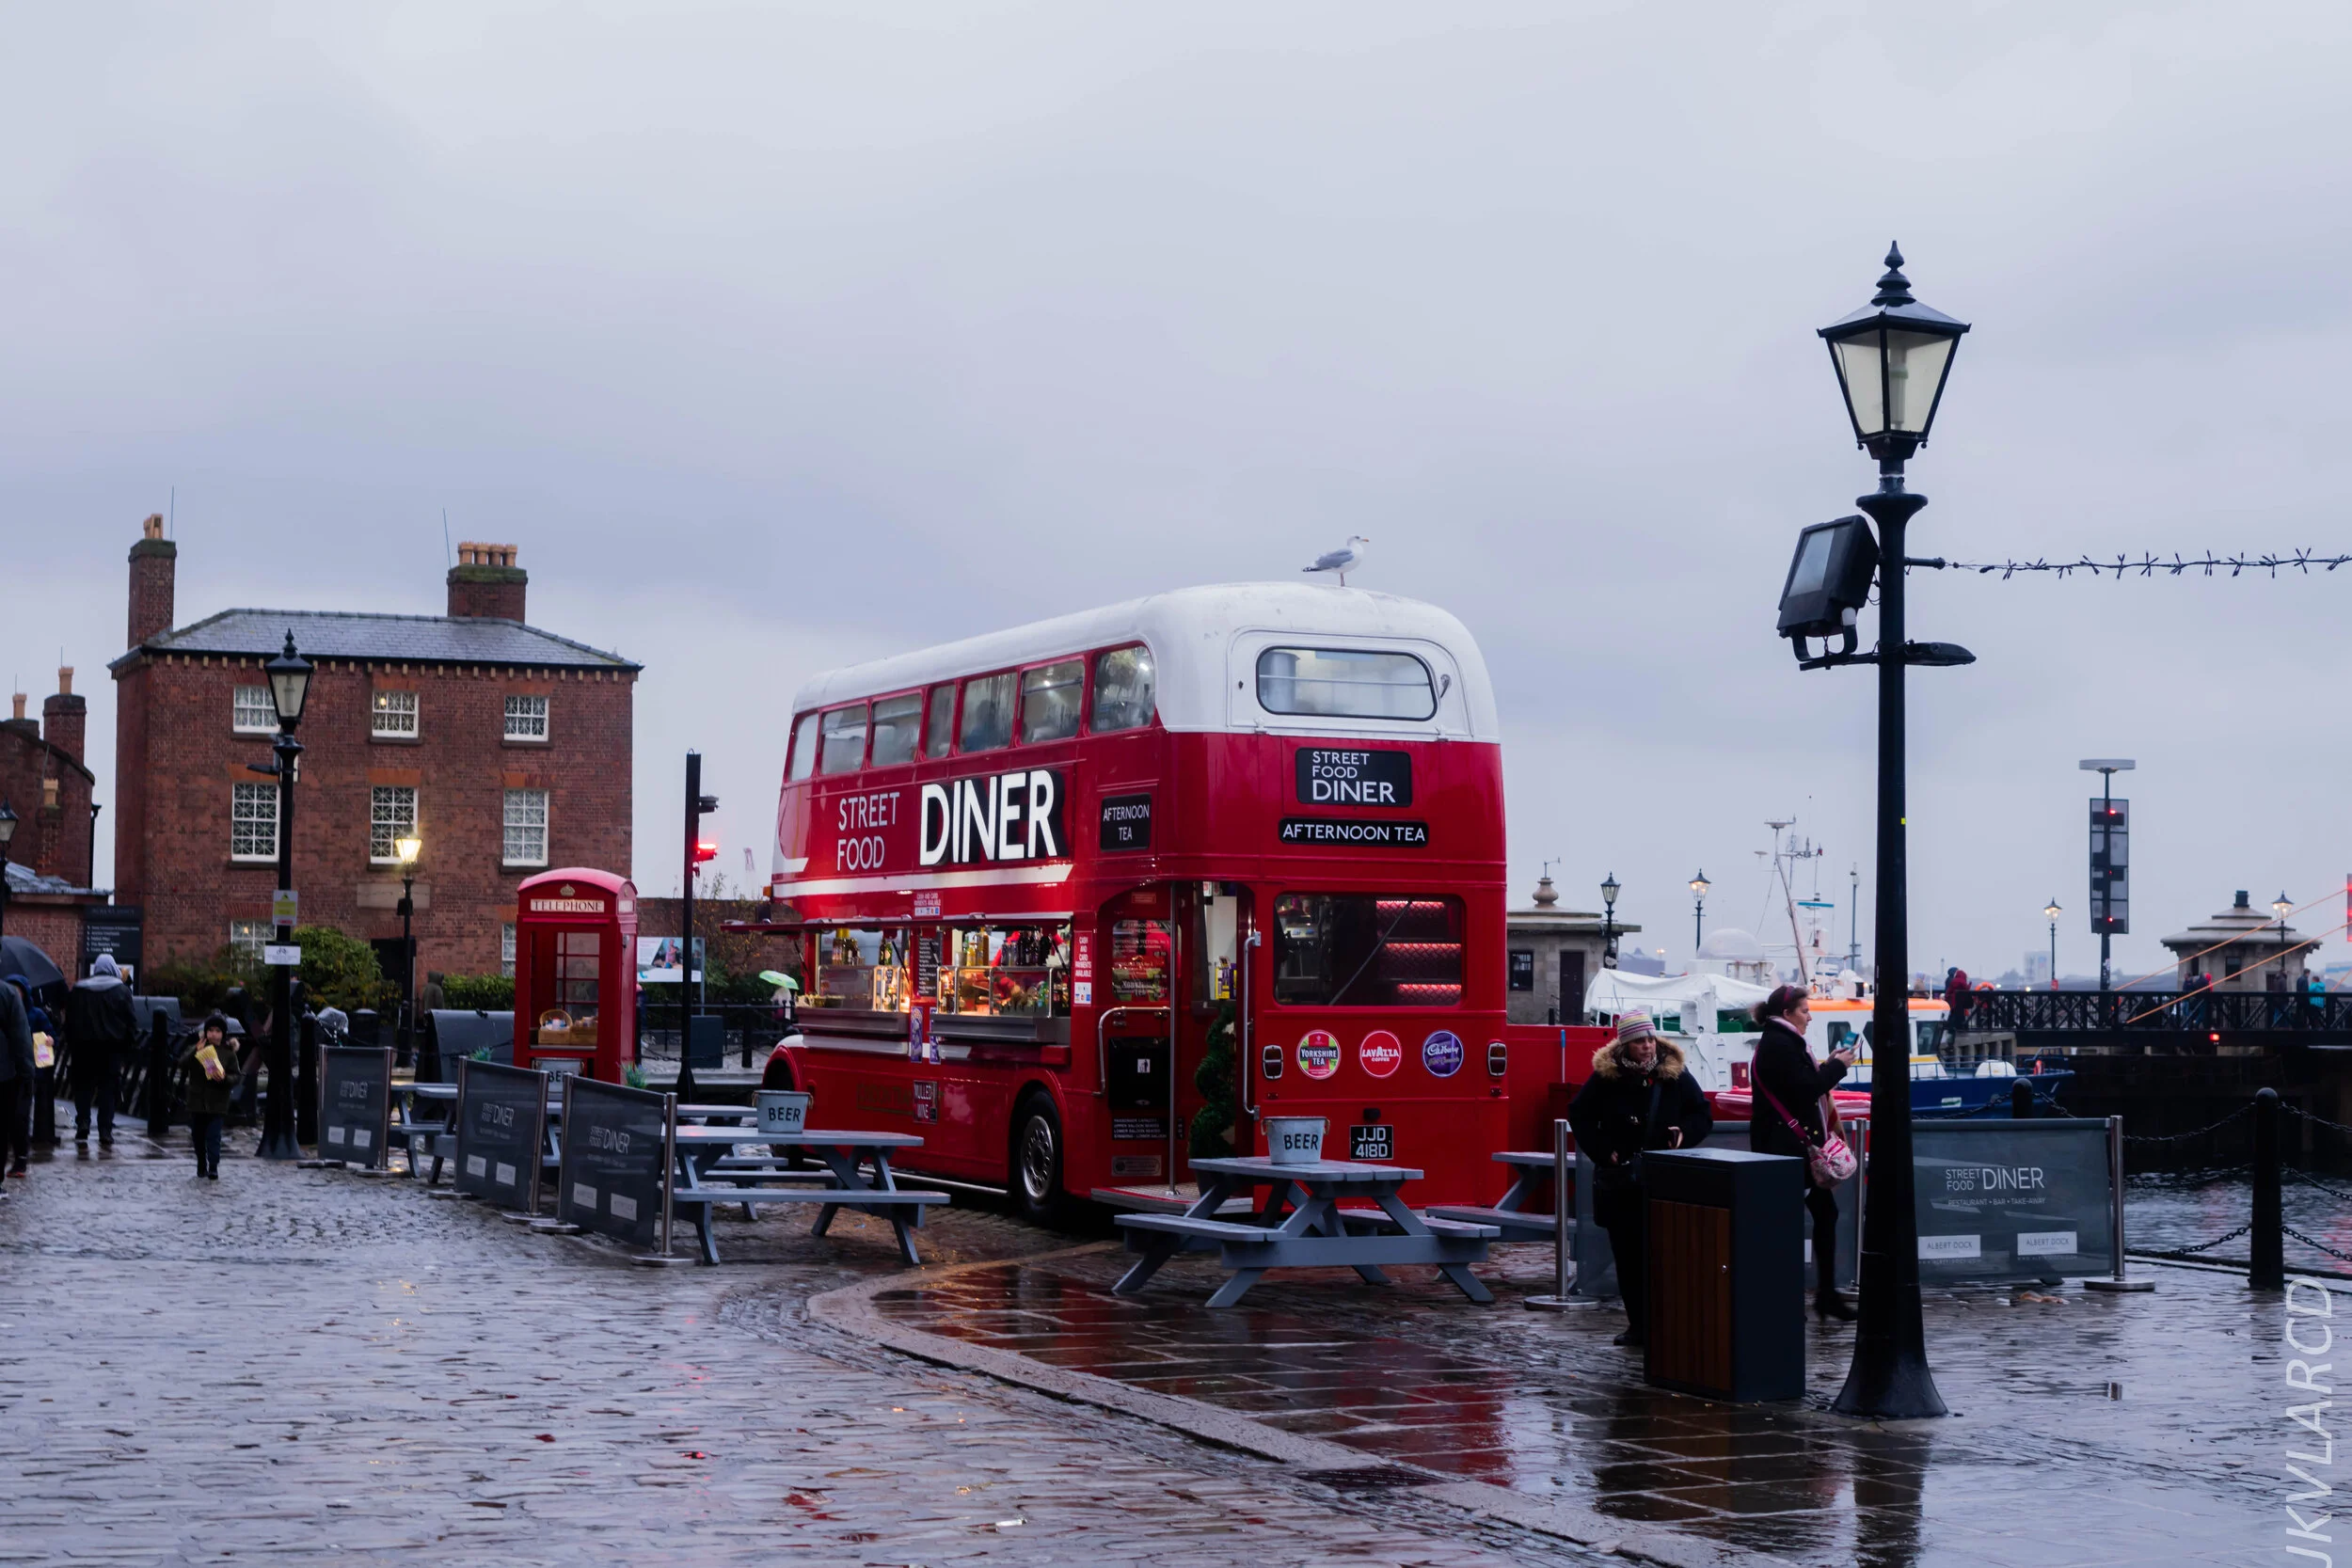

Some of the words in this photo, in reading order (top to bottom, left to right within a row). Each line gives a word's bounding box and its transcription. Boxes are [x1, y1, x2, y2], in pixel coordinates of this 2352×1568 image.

[1311, 751, 1371, 766] STREET
[1311, 765, 1358, 779] FOOD
[1311, 779, 1396, 803] DINER
[837, 791, 900, 832] STREET
[918, 769, 1058, 866] DINER
[1103, 804, 1150, 822] AFTERNOON
[1119, 827, 1133, 841] TEA
[1282, 823, 1390, 841] AFTERNOON
[1394, 827, 1426, 842] TEA
[836, 835, 885, 871] FOOD
[532, 900, 603, 911] TELEPHONE
[1300, 1048, 1337, 1058] YORKSHIRE
[1361, 1046, 1400, 1057] LAVAZZA
[1427, 1042, 1459, 1056] Cadbury
[1312, 1057, 1326, 1066] TEA
[492, 1105, 515, 1128] DINER
[768, 1106, 802, 1121] BEER
[1283, 1133, 1319, 1150] BEER
[1357, 1127, 1386, 1141] JJD
[602, 1129, 630, 1155] DINER
[1355, 1143, 1388, 1158] 418D
[1945, 1168, 1980, 1180] STREET
[1982, 1167, 2045, 1190] DINER
[1947, 1180, 1975, 1191] FOOD
[1927, 1242, 1952, 1250] ALBERT
[1953, 1241, 1973, 1249] DOCK
